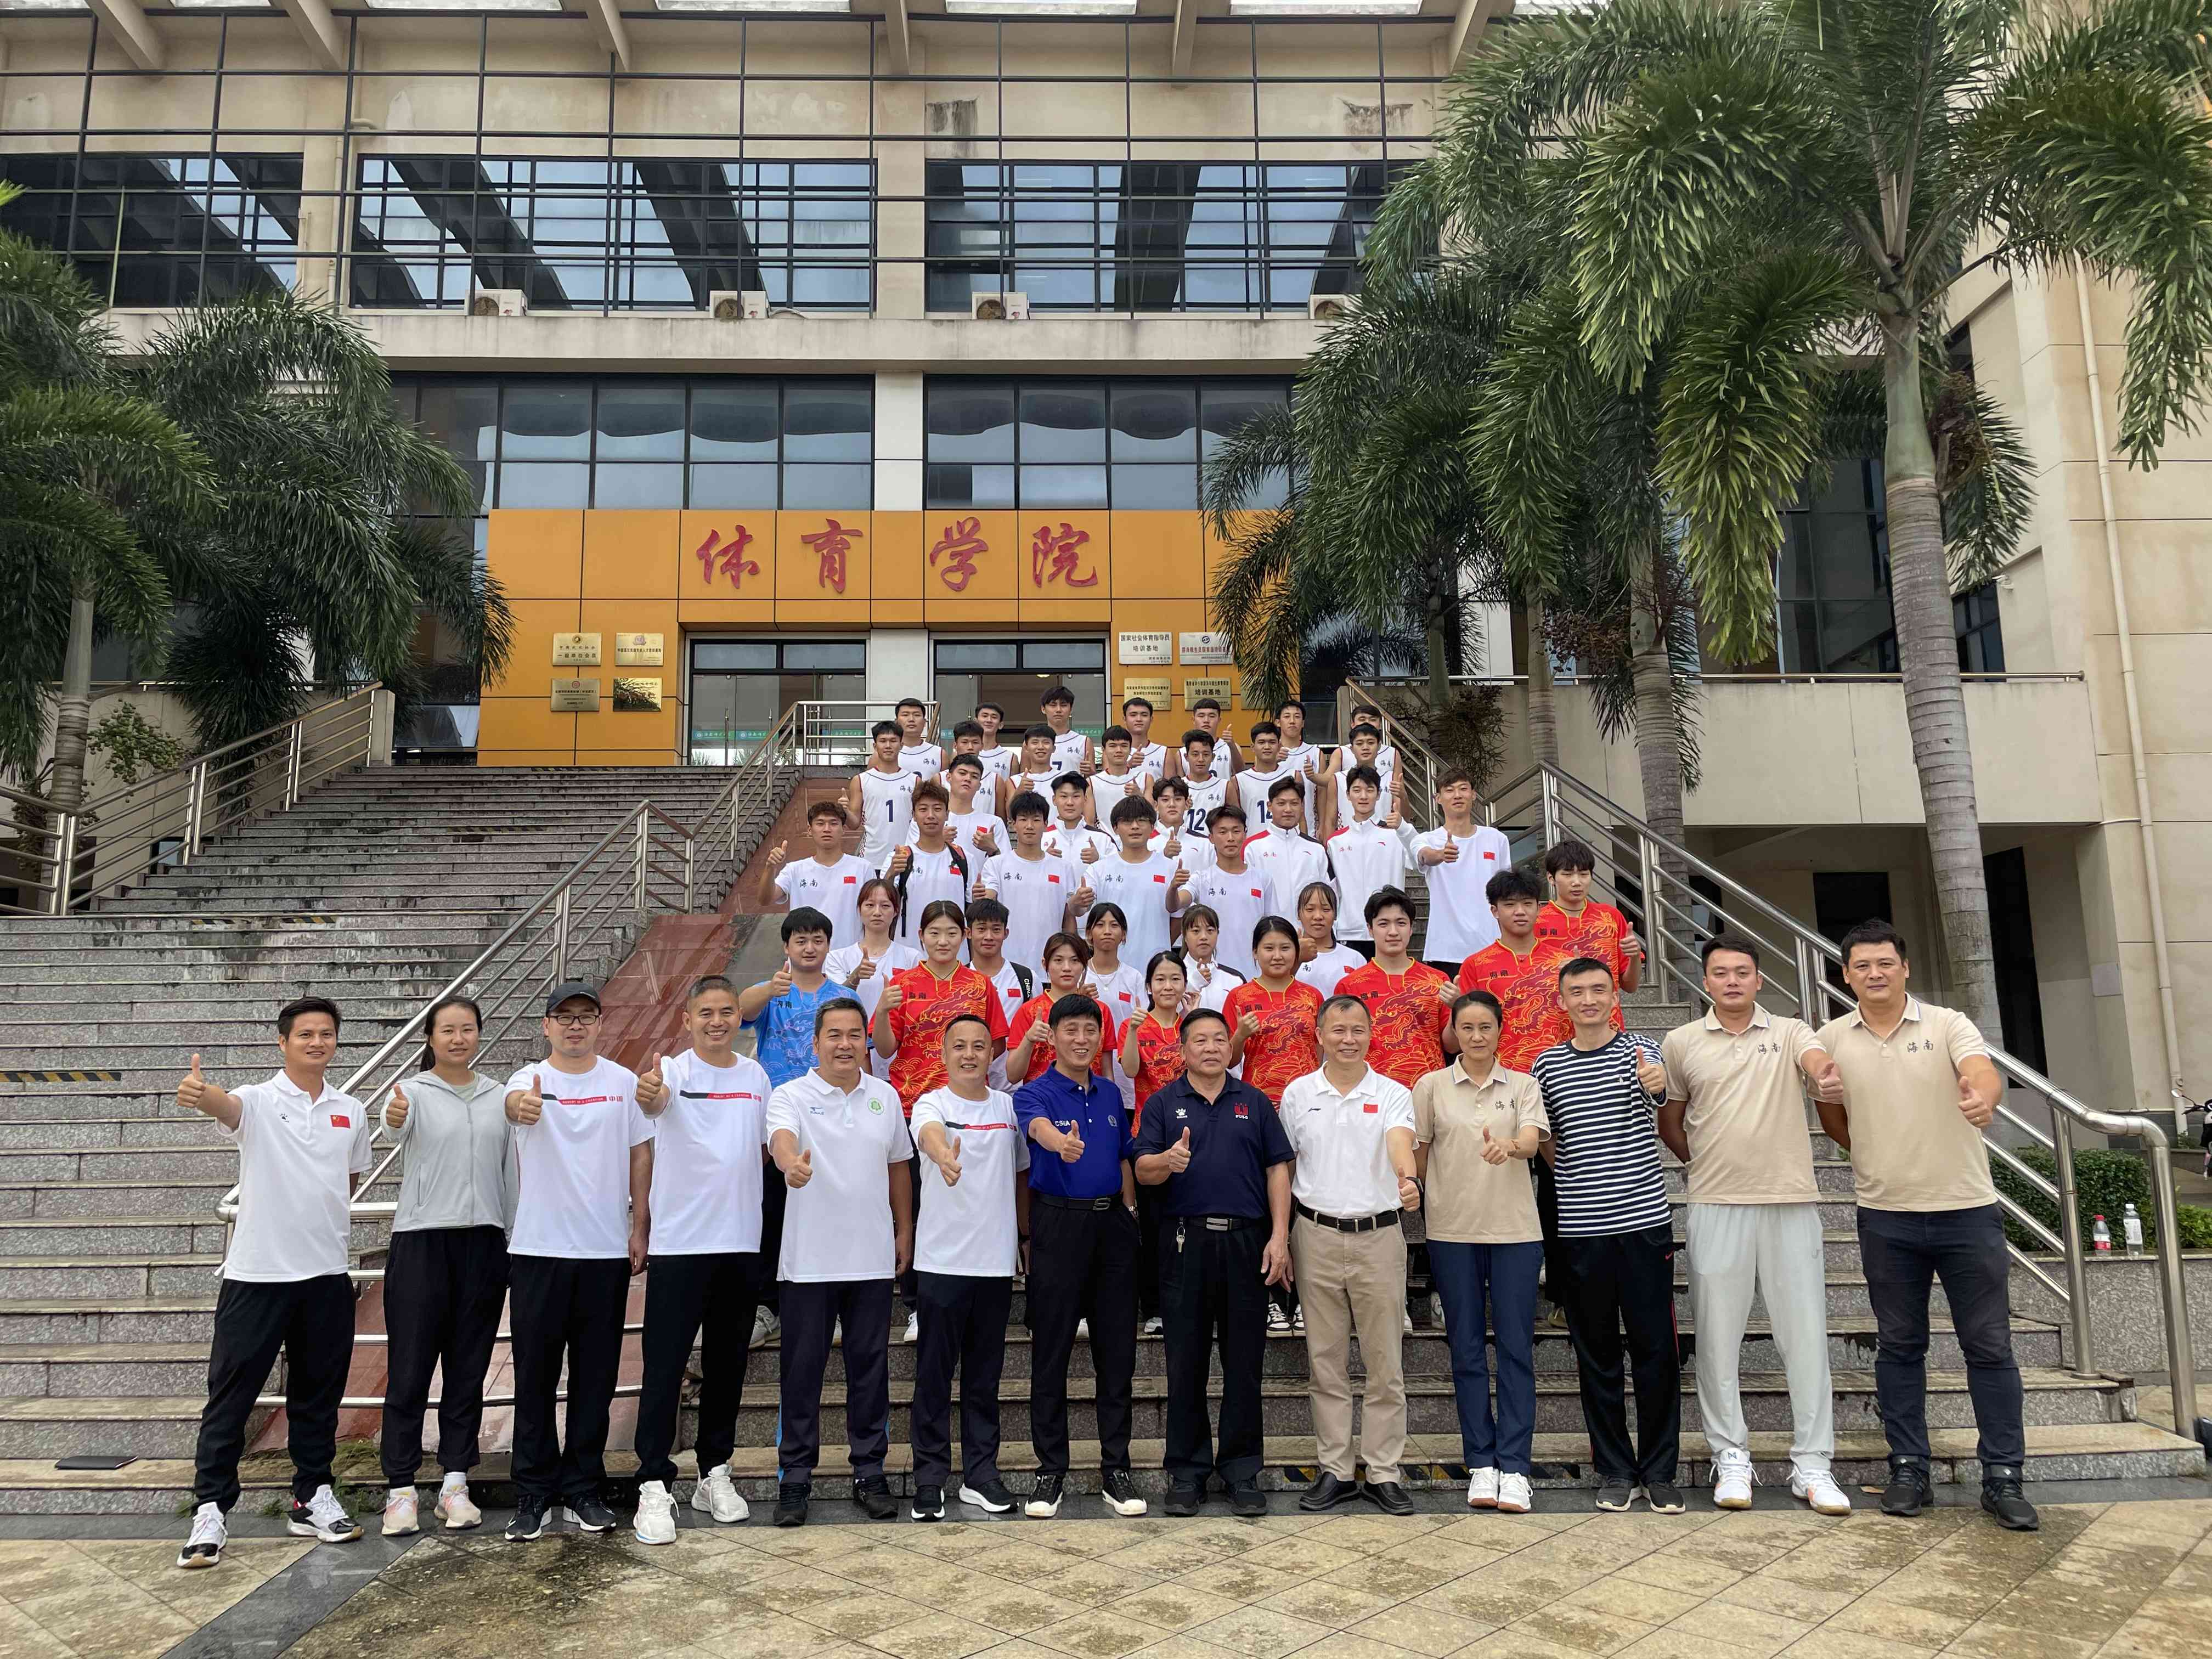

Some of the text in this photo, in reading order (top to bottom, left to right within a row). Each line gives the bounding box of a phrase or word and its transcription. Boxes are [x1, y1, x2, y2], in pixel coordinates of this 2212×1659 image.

[697, 516, 1098, 594] 体育学院
[885, 799, 894, 822] 1
[1187, 808, 1206, 831] 12
[1004, 872, 1022, 881] 海南
[1105, 874, 1123, 883] 海南
[799, 879, 818, 888] 海南
[1208, 887, 1227, 896] 海南
[1757, 1042, 1781, 1053] 海南
[1906, 1040, 1934, 1053] 海南
[1495, 1098, 1515, 1110] 海南
